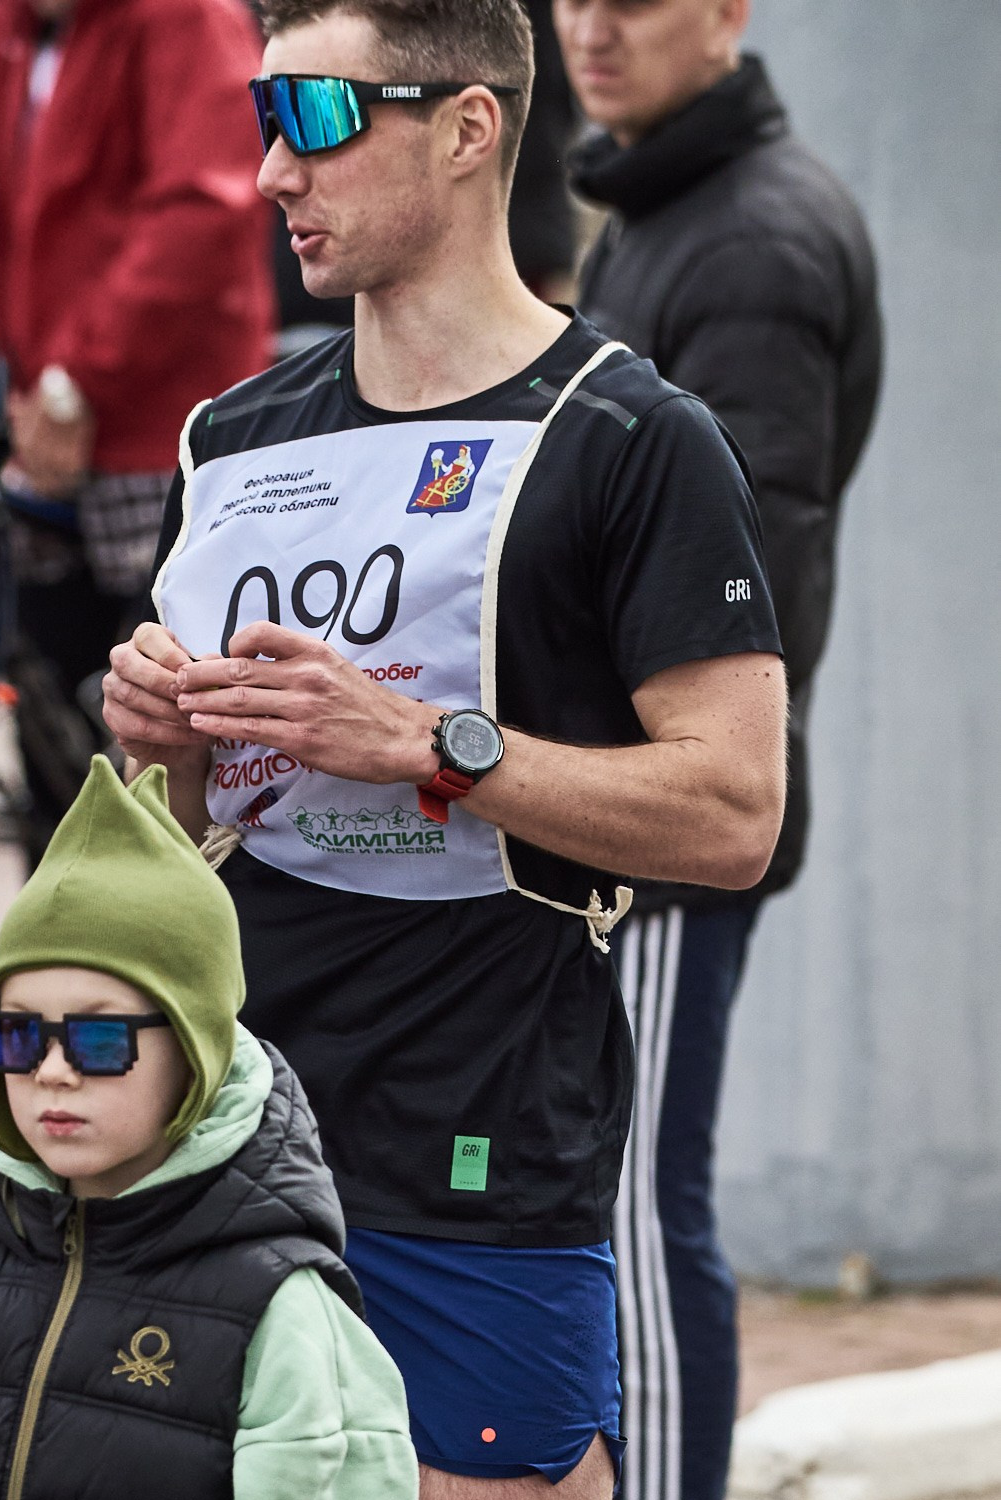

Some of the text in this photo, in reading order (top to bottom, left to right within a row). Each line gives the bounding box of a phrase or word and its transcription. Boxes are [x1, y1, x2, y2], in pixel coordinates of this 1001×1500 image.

[244, 469, 314, 489] Федерация
[261, 482, 331, 498] атлетики
[279, 496, 339, 513] области
[725, 579, 751, 602] GRi
[221, 544, 404, 658] 090
[214, 753, 314, 789] ЗОЛОТО
[375, 845, 446, 854] БАССЕЙН
